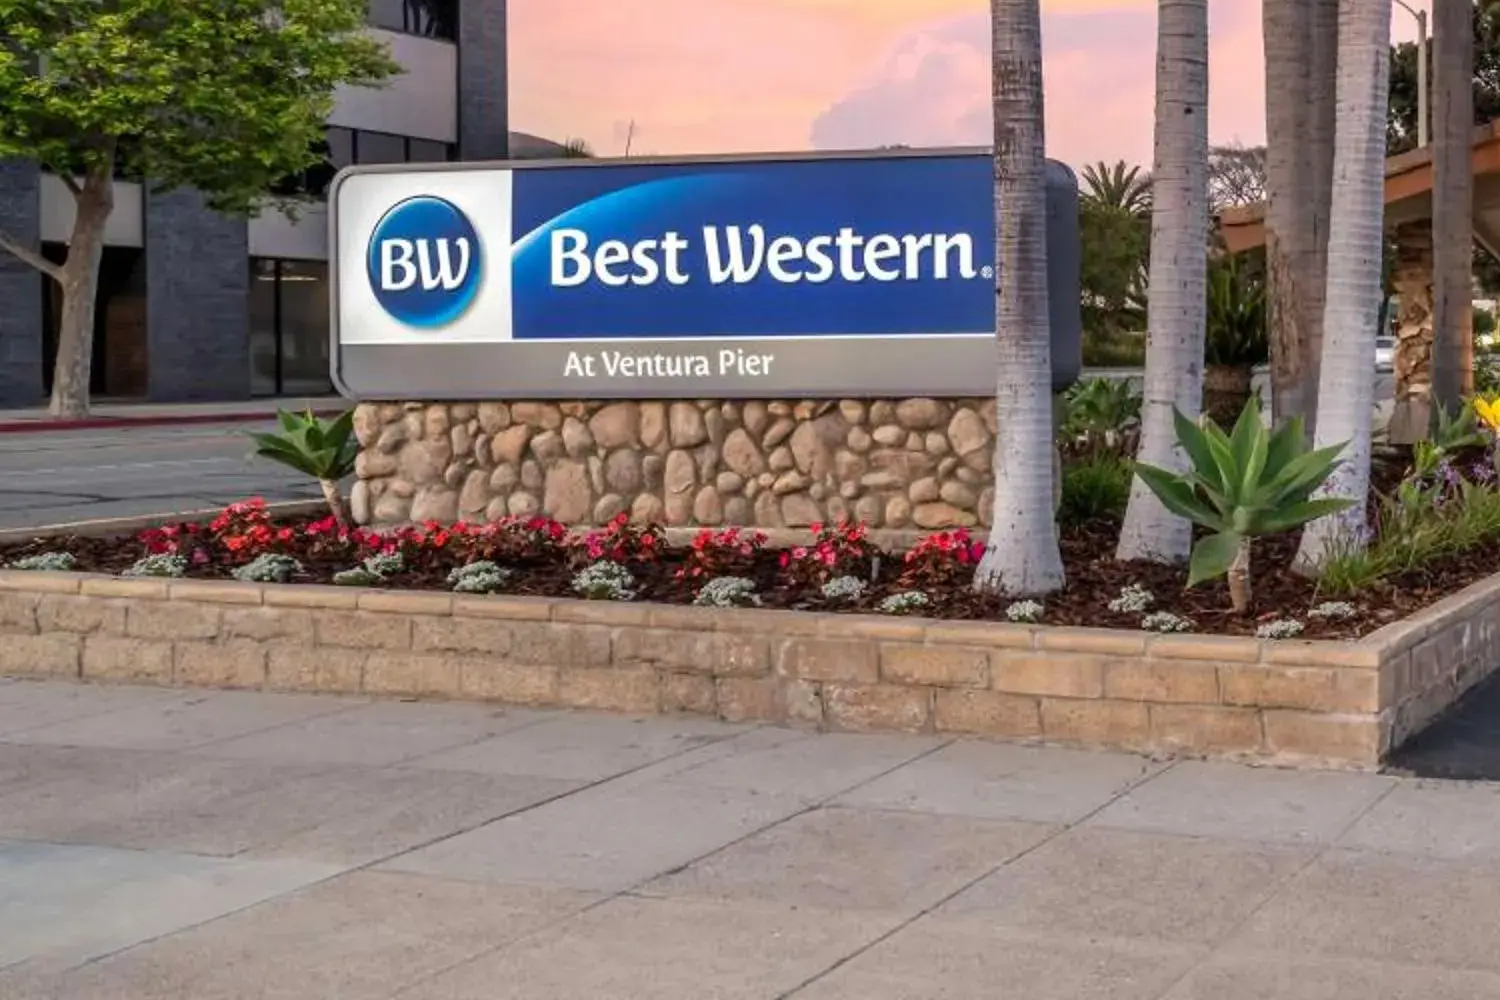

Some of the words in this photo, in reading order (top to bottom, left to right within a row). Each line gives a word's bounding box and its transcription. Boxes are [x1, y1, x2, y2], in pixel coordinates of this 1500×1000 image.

[380, 237, 470, 292] BW
[551, 230, 690, 287] Best
[563, 350, 597, 378] At
[600, 350, 712, 378] Ventura
[718, 347, 776, 377] Pier
